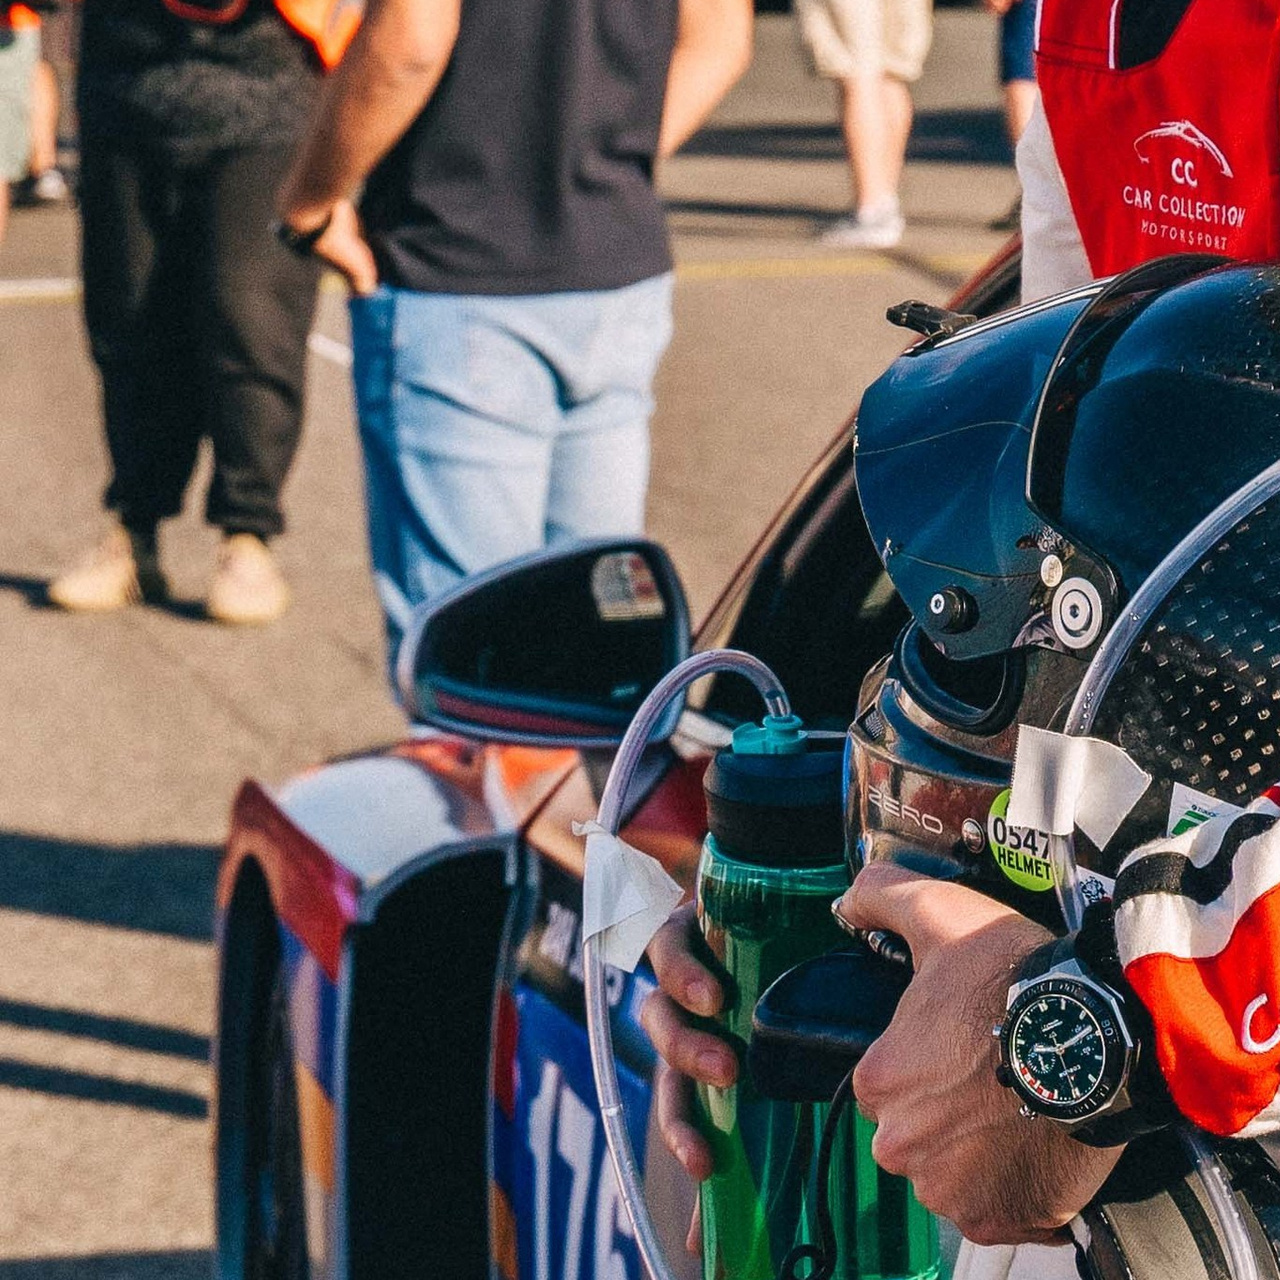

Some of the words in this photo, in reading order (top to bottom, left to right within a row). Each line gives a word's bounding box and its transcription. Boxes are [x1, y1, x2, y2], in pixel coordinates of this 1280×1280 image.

[1171, 157, 1198, 188] CC
[1123, 186, 1152, 210] CAR
[1159, 194, 1246, 228] COLLECTION
[1141, 220, 1228, 250] MOTORSPORT
[868, 784, 944, 834] ZERO
[993, 817, 1050, 861] 0547
[997, 846, 1052, 881] HELMET
